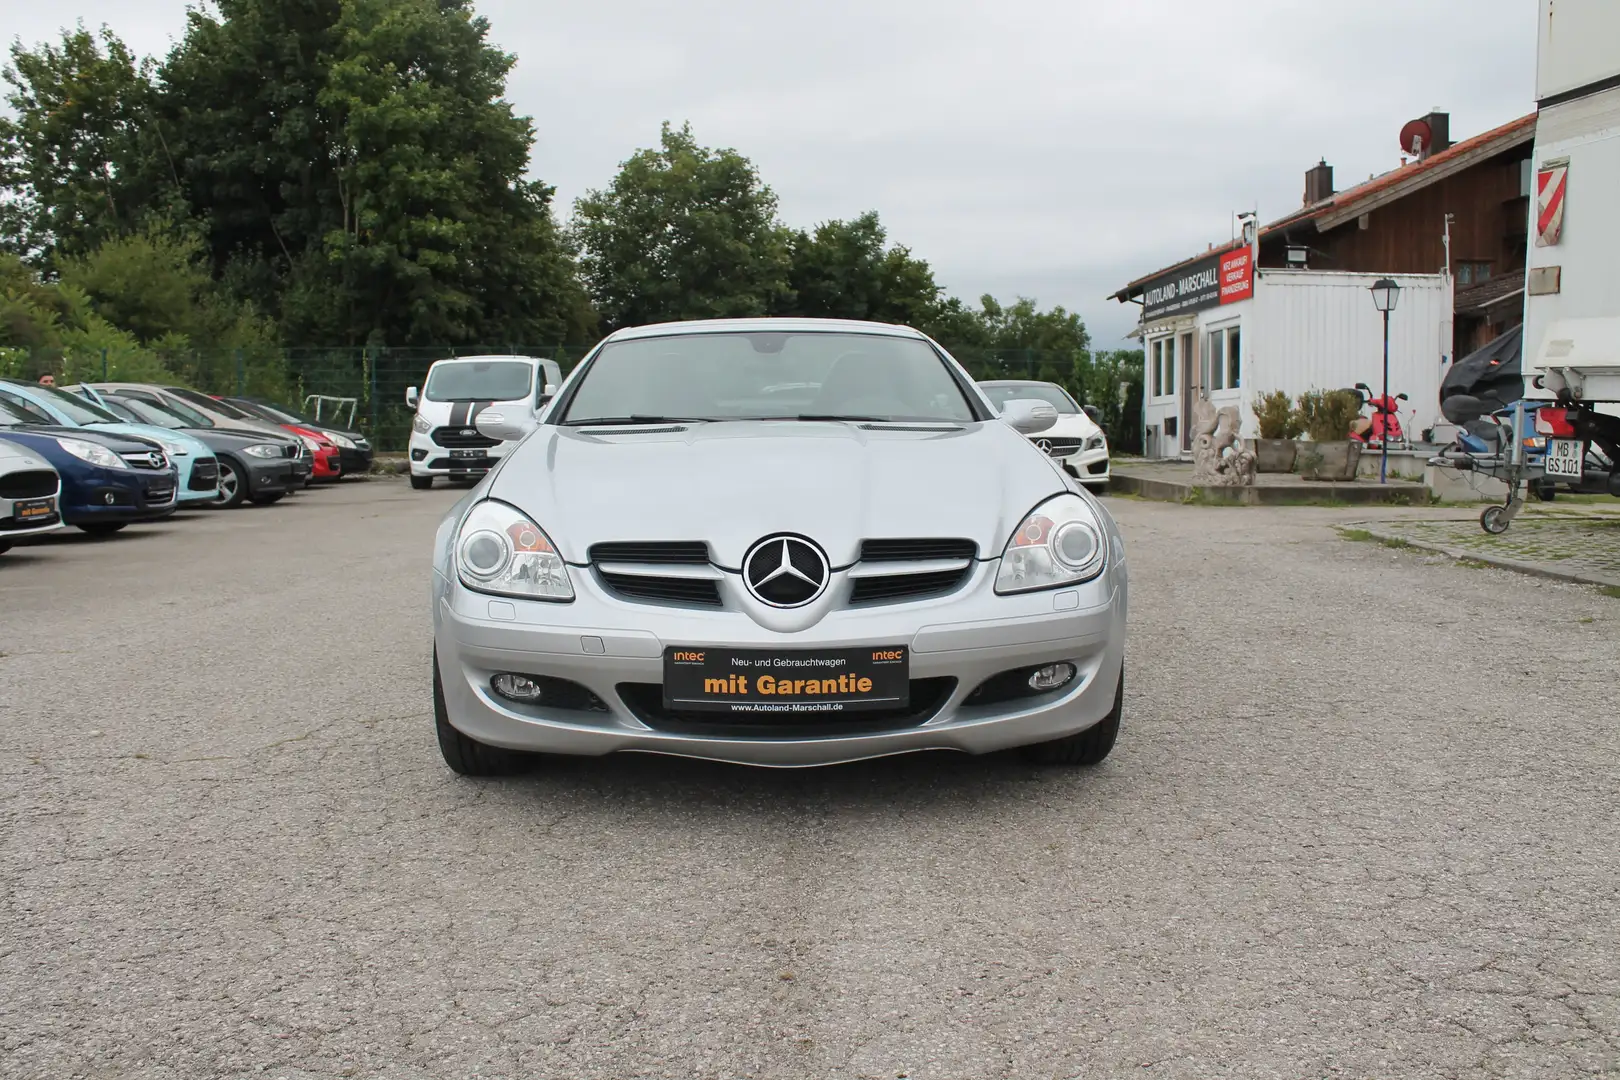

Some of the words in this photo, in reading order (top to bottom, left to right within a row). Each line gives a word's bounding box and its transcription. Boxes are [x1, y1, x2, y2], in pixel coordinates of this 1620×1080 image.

[1145, 283, 1175, 307] AUTOLAND
[1179, 267, 1218, 296] MARSCHALL
[1556, 442, 1569, 457] MB
[1548, 458, 1560, 473] GS
[1562, 459, 1579, 474] 101
[673, 651, 705, 661] intec
[872, 650, 903, 661] intec
[731, 657, 753, 667] Neu-
[754, 658, 771, 667] und
[773, 657, 846, 668] Gebrauchtwagen
[704, 673, 748, 694] mit
[756, 673, 873, 695] Garantie
[731, 703, 844, 712] www.Autoland-Marschall.de
